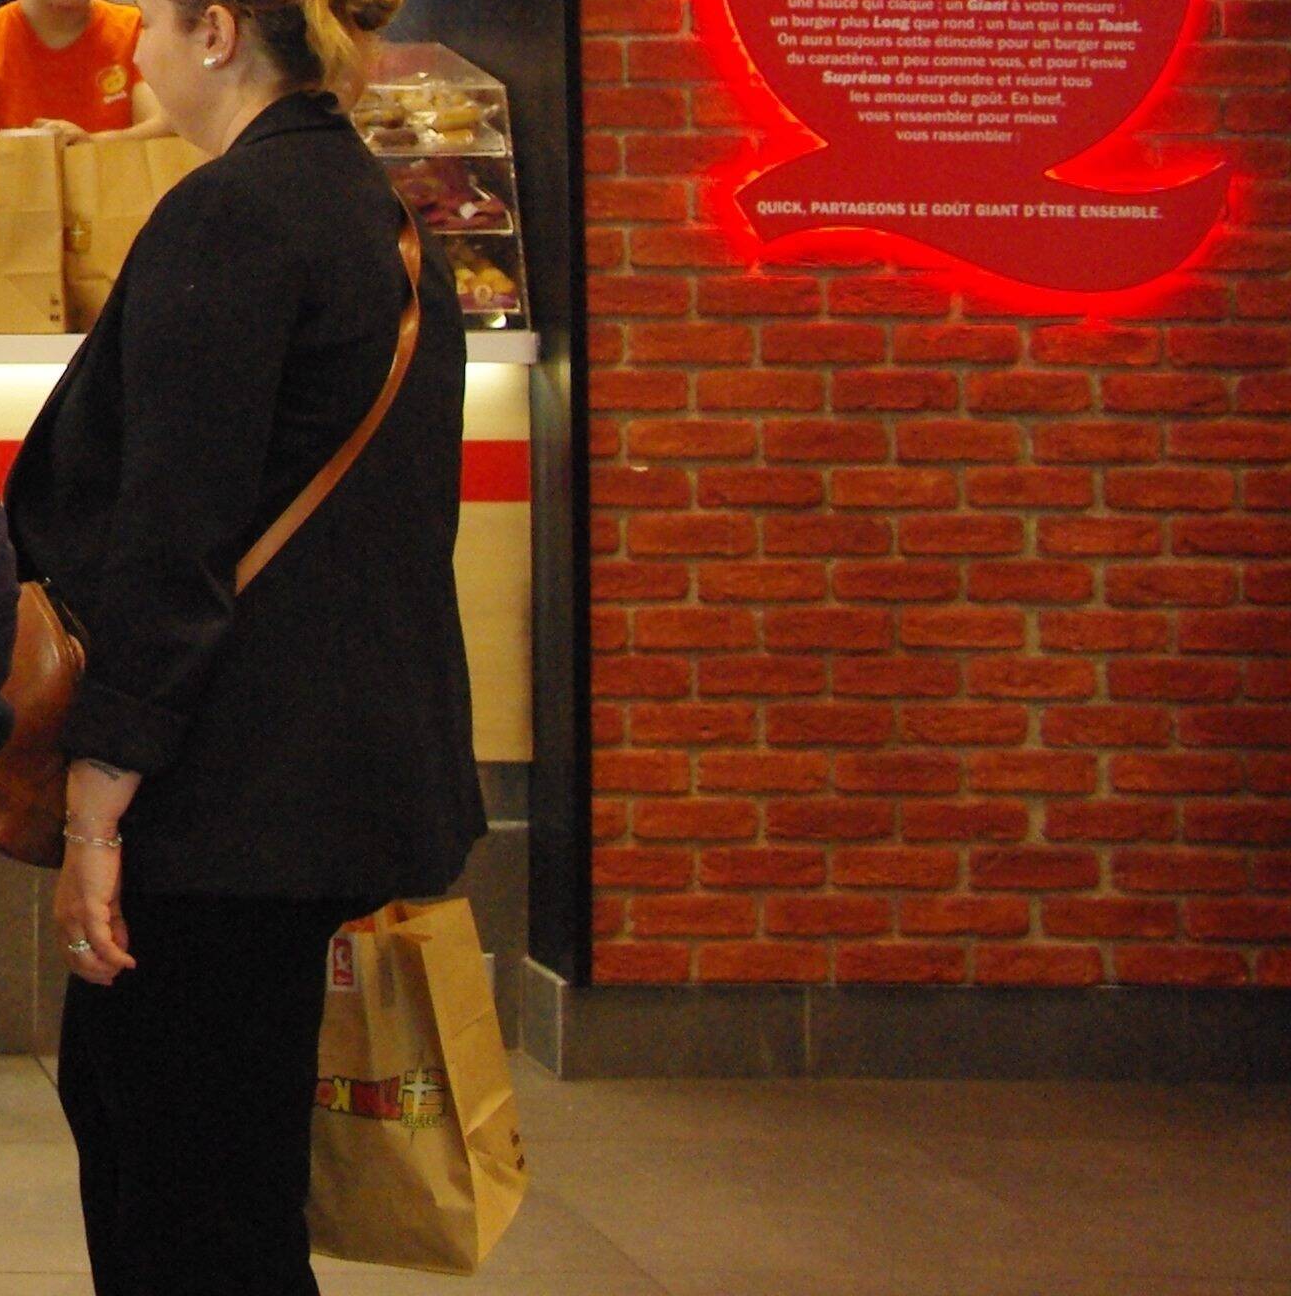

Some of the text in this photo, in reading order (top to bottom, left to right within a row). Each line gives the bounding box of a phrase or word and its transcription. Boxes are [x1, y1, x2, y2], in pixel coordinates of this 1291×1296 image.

[817, 0, 857, 8] sauce
[946, 1, 962, 10] un
[1024, 1, 1058, 11] votre
[1062, 3, 1114, 12] mesure
[771, 15, 1093, 32] un burger plus Long que rond un bun qui du
[777, 32, 1134, 52] On aura toujours cette étincelle pour un burger avec
[787, 52, 804, 64] du
[882, 56, 899, 65] un
[903, 56, 929, 67] peu
[932, 56, 985, 66] comme
[1029, 57, 1042, 67] et
[1046, 58, 1077, 69] pour
[823, 71, 1091, 86] Suprême de surprendre et réunir tous
[850, 90, 1028, 104] les amoureux du En
[858, 110, 1057, 124] vous ressembler pour mieux
[896, 130, 1011, 141] vous rassembler
[757, 201, 1161, 218] QUICK, PARTAGEONS LE GOÛT GIANT D'ÊTRE ENSEMBLE.
